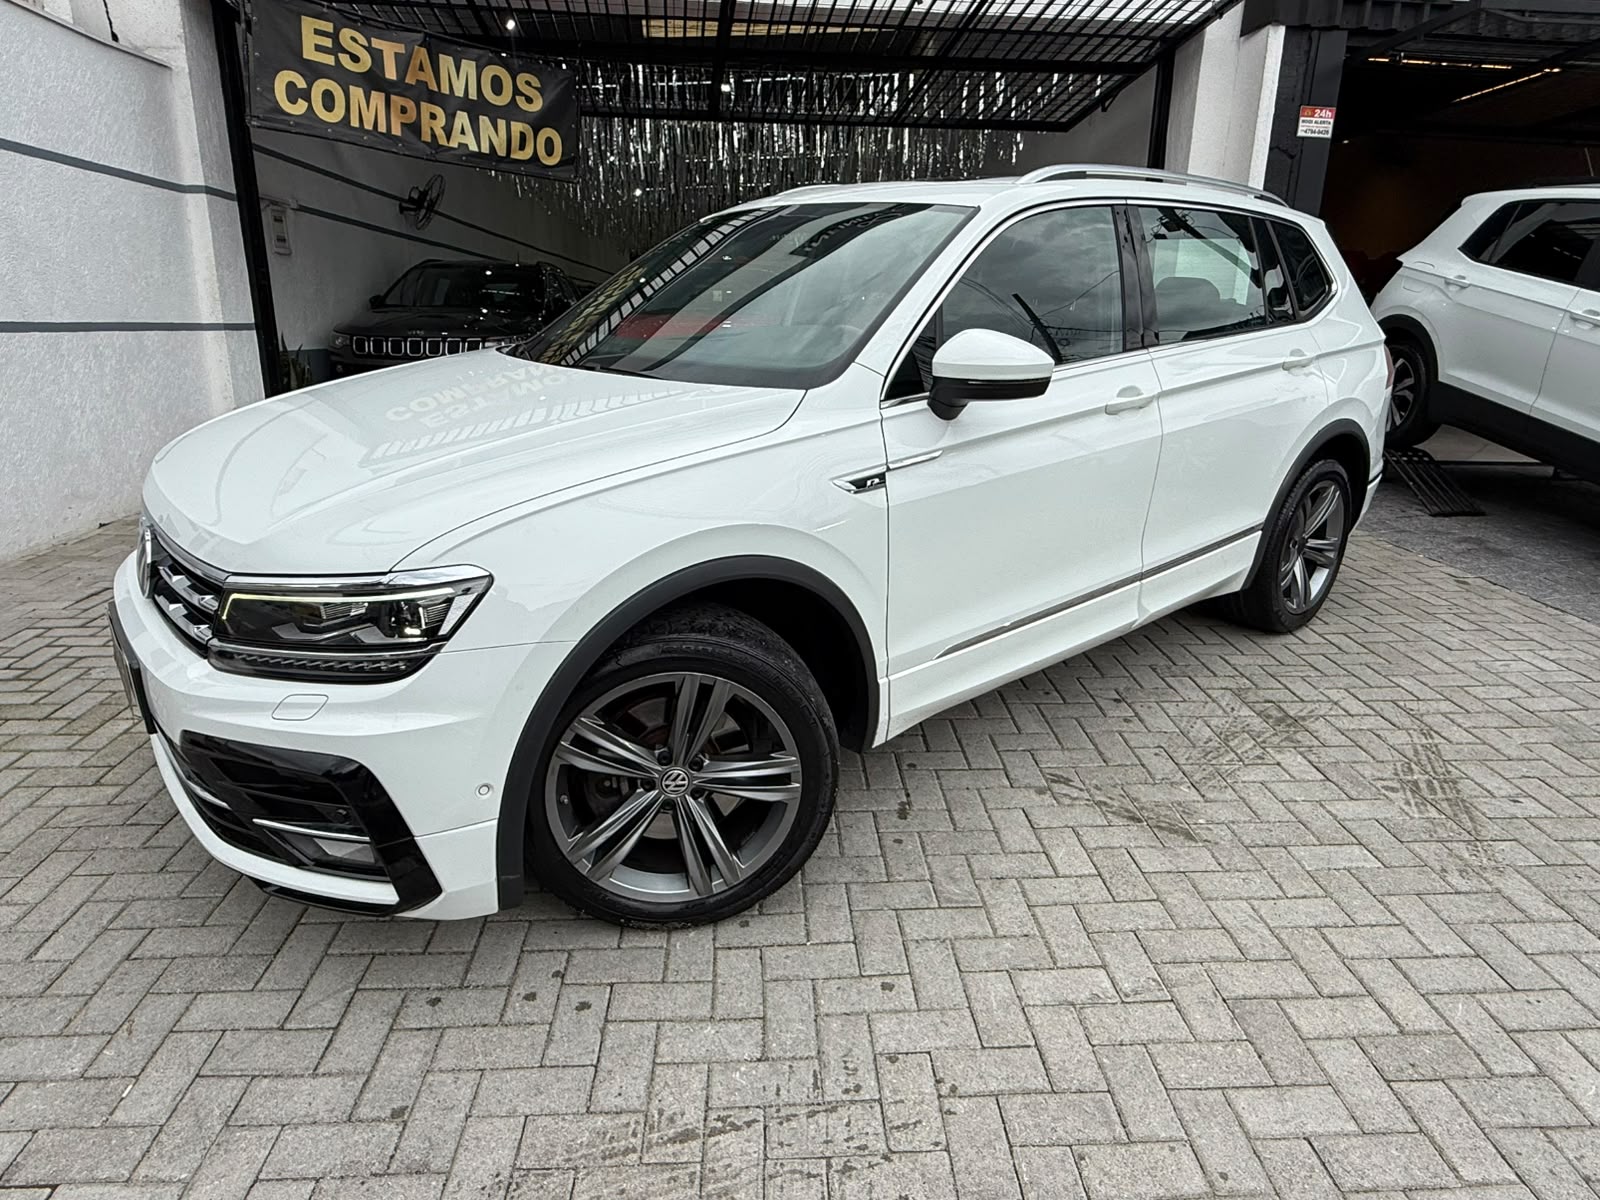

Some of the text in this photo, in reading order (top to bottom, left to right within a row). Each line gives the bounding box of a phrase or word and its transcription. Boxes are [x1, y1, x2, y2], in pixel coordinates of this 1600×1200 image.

[301, 15, 544, 112] ESTAMOS
[274, 70, 562, 166] COMPRANDO
[1314, 109, 1332, 118] 24h
